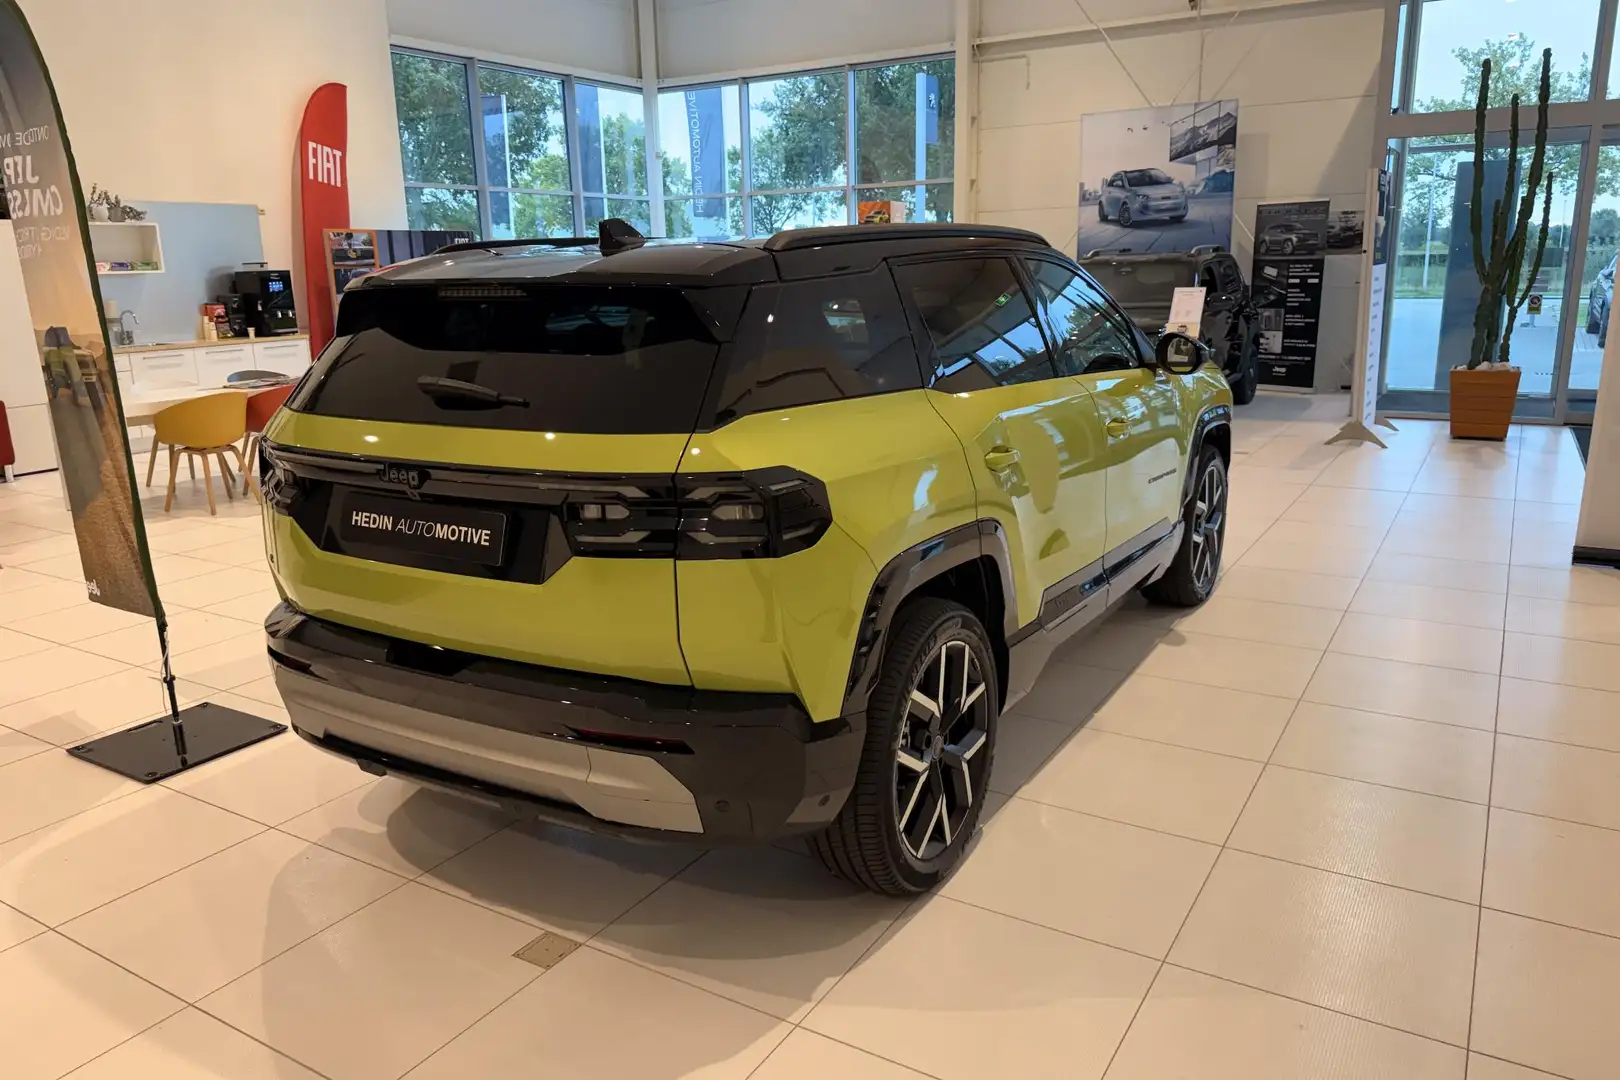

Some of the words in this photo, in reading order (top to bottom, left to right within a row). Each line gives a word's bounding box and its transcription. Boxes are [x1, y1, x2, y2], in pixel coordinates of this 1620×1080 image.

[308, 140, 342, 188] FIAT
[380, 463, 419, 488] Jeep
[351, 510, 393, 531] HEDIN
[395, 517, 491, 546] AUTOMOTIVE
